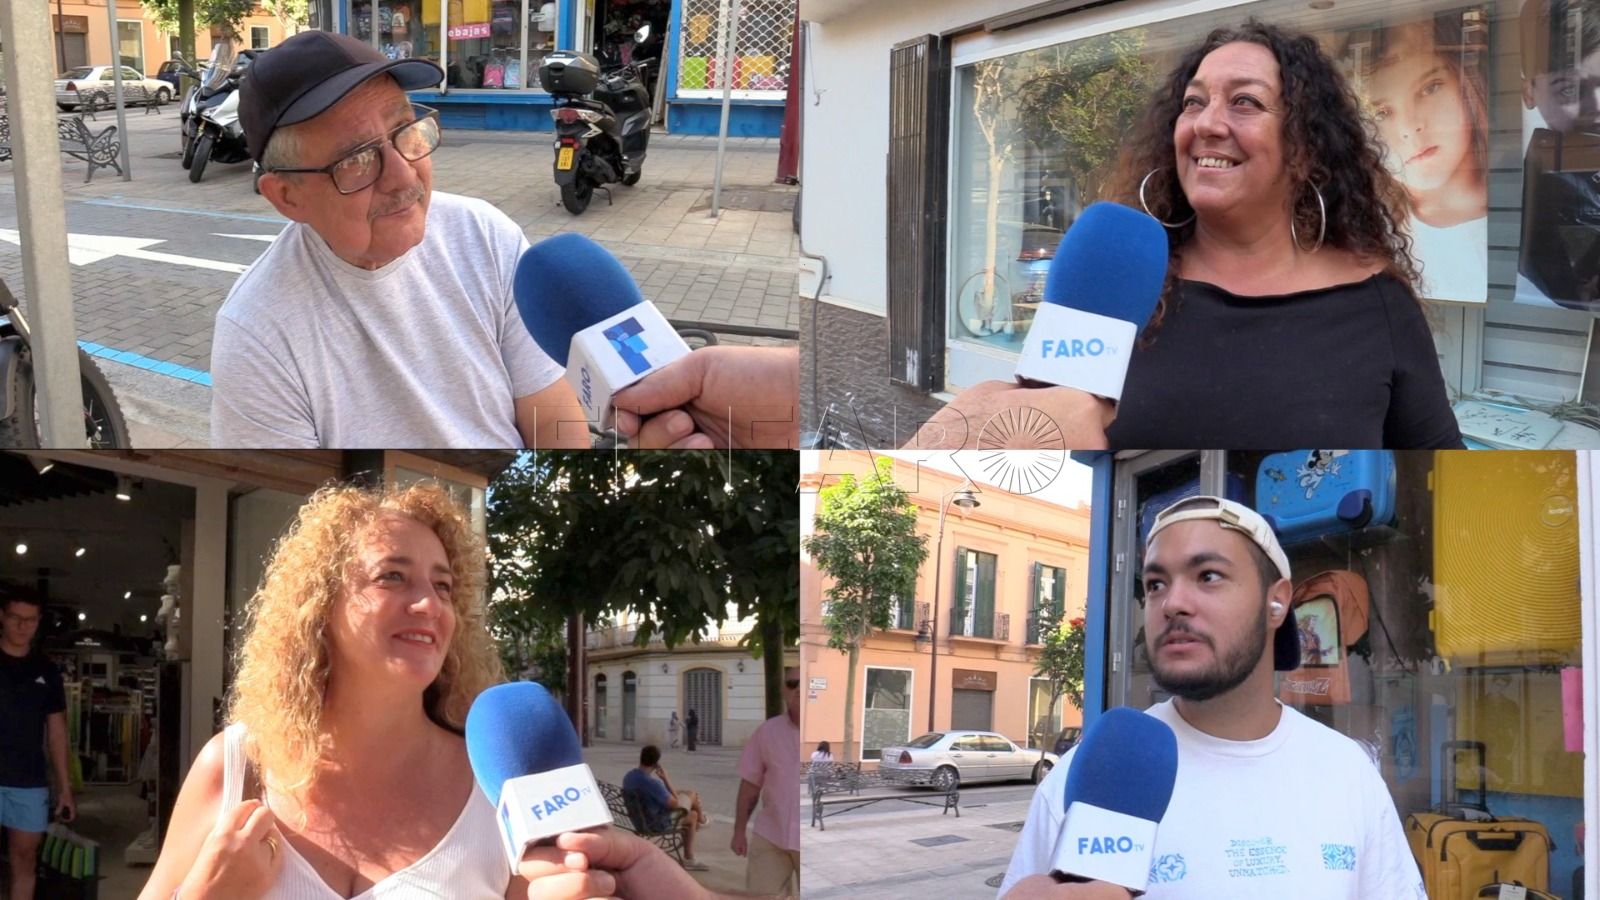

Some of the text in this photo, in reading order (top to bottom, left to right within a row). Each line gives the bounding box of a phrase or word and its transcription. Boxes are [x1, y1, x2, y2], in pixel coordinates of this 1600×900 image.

[448, 26, 488, 38] ebajas
[1042, 338, 1104, 359] FARO
[581, 367, 592, 410] FARO
[531, 787, 580, 821] FARO
[1078, 836, 1133, 855] FARO
[1225, 848, 1246, 858] THE
